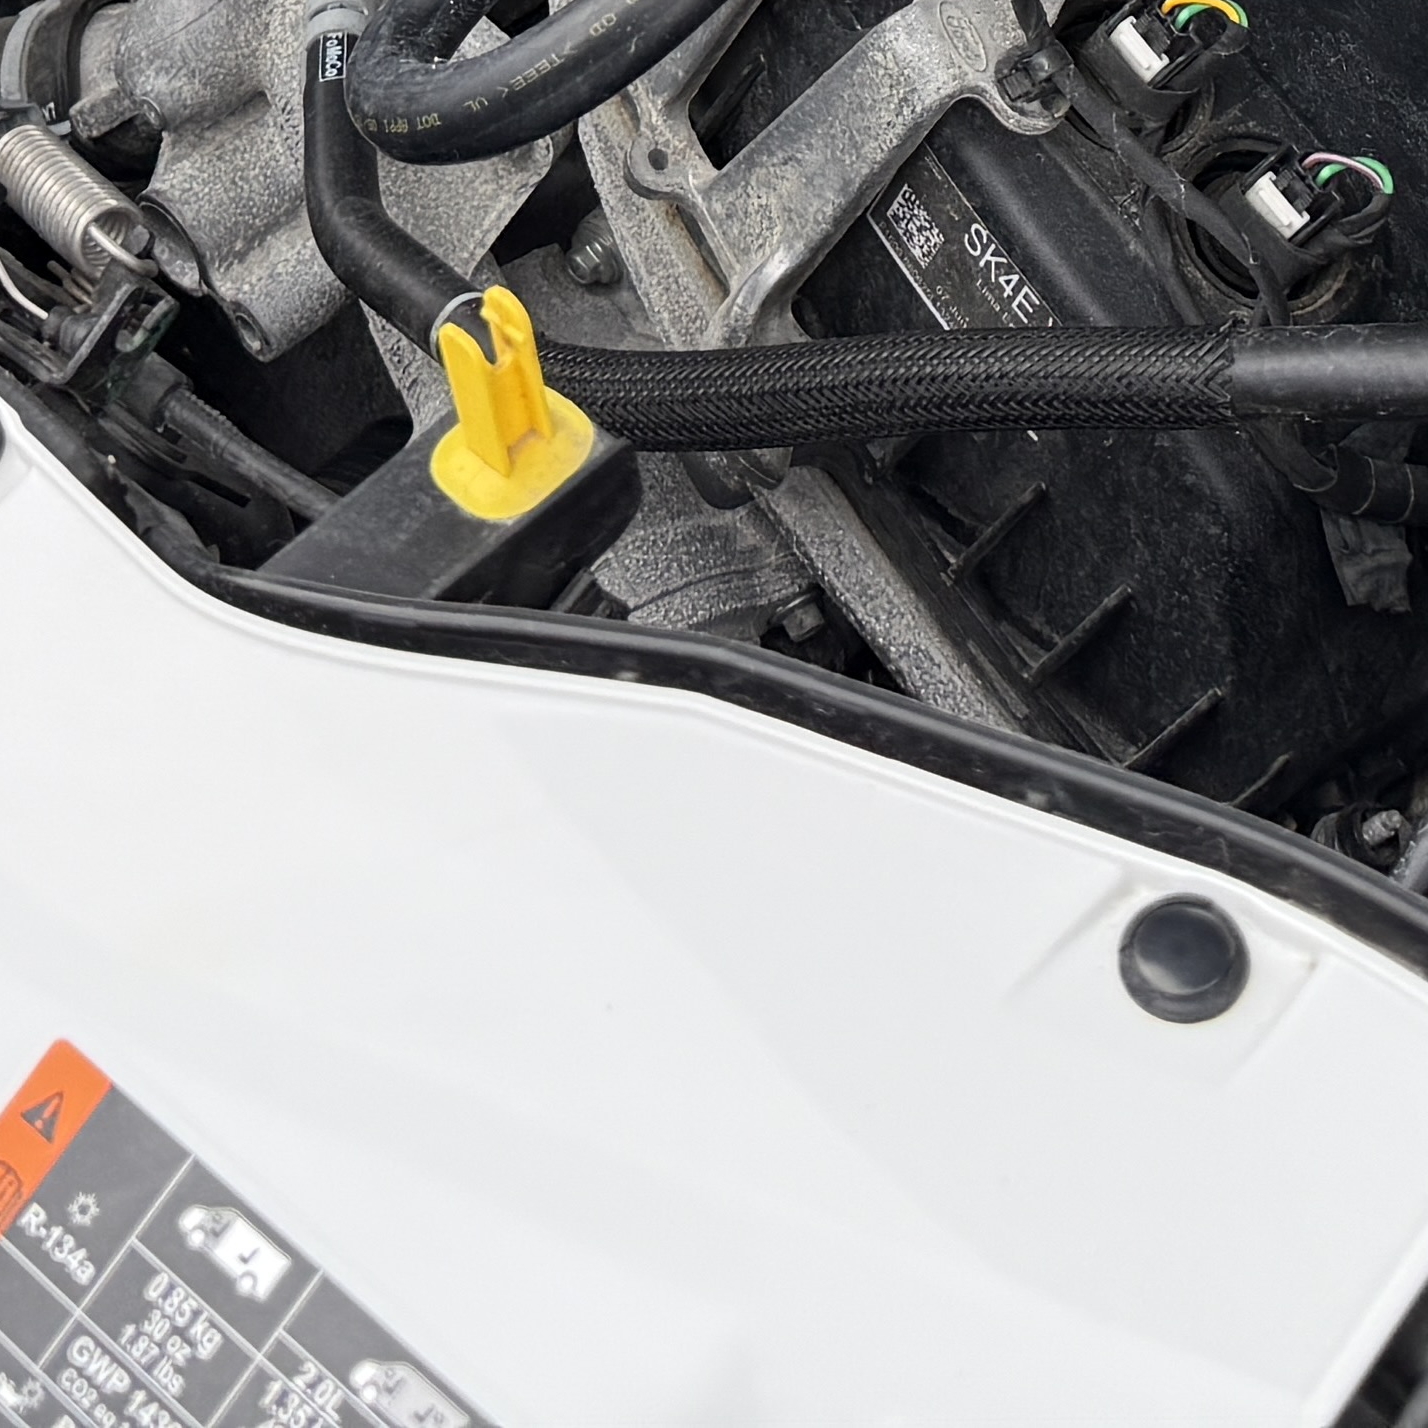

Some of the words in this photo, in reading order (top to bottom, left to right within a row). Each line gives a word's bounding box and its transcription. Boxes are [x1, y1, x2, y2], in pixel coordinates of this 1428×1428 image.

[325, 31, 343, 77] FoMoCo
[944, 10, 985, 66] Ford
[415, 112, 443, 131] DOT
[462, 95, 491, 116] UL
[962, 222, 1039, 326] SK4E
[18, 1203, 95, 1285] R-134a
[143, 1310, 170, 1342] 30
[167, 1336, 191, 1366] oz
[145, 1271, 200, 1327] 0.85
[189, 1310, 230, 1360] kg
[67, 1336, 131, 1394] GWP
[119, 1325, 160, 1365] 1.87
[153, 1356, 184, 1396] lbs
[292, 1361, 346, 1425] 2.0L
